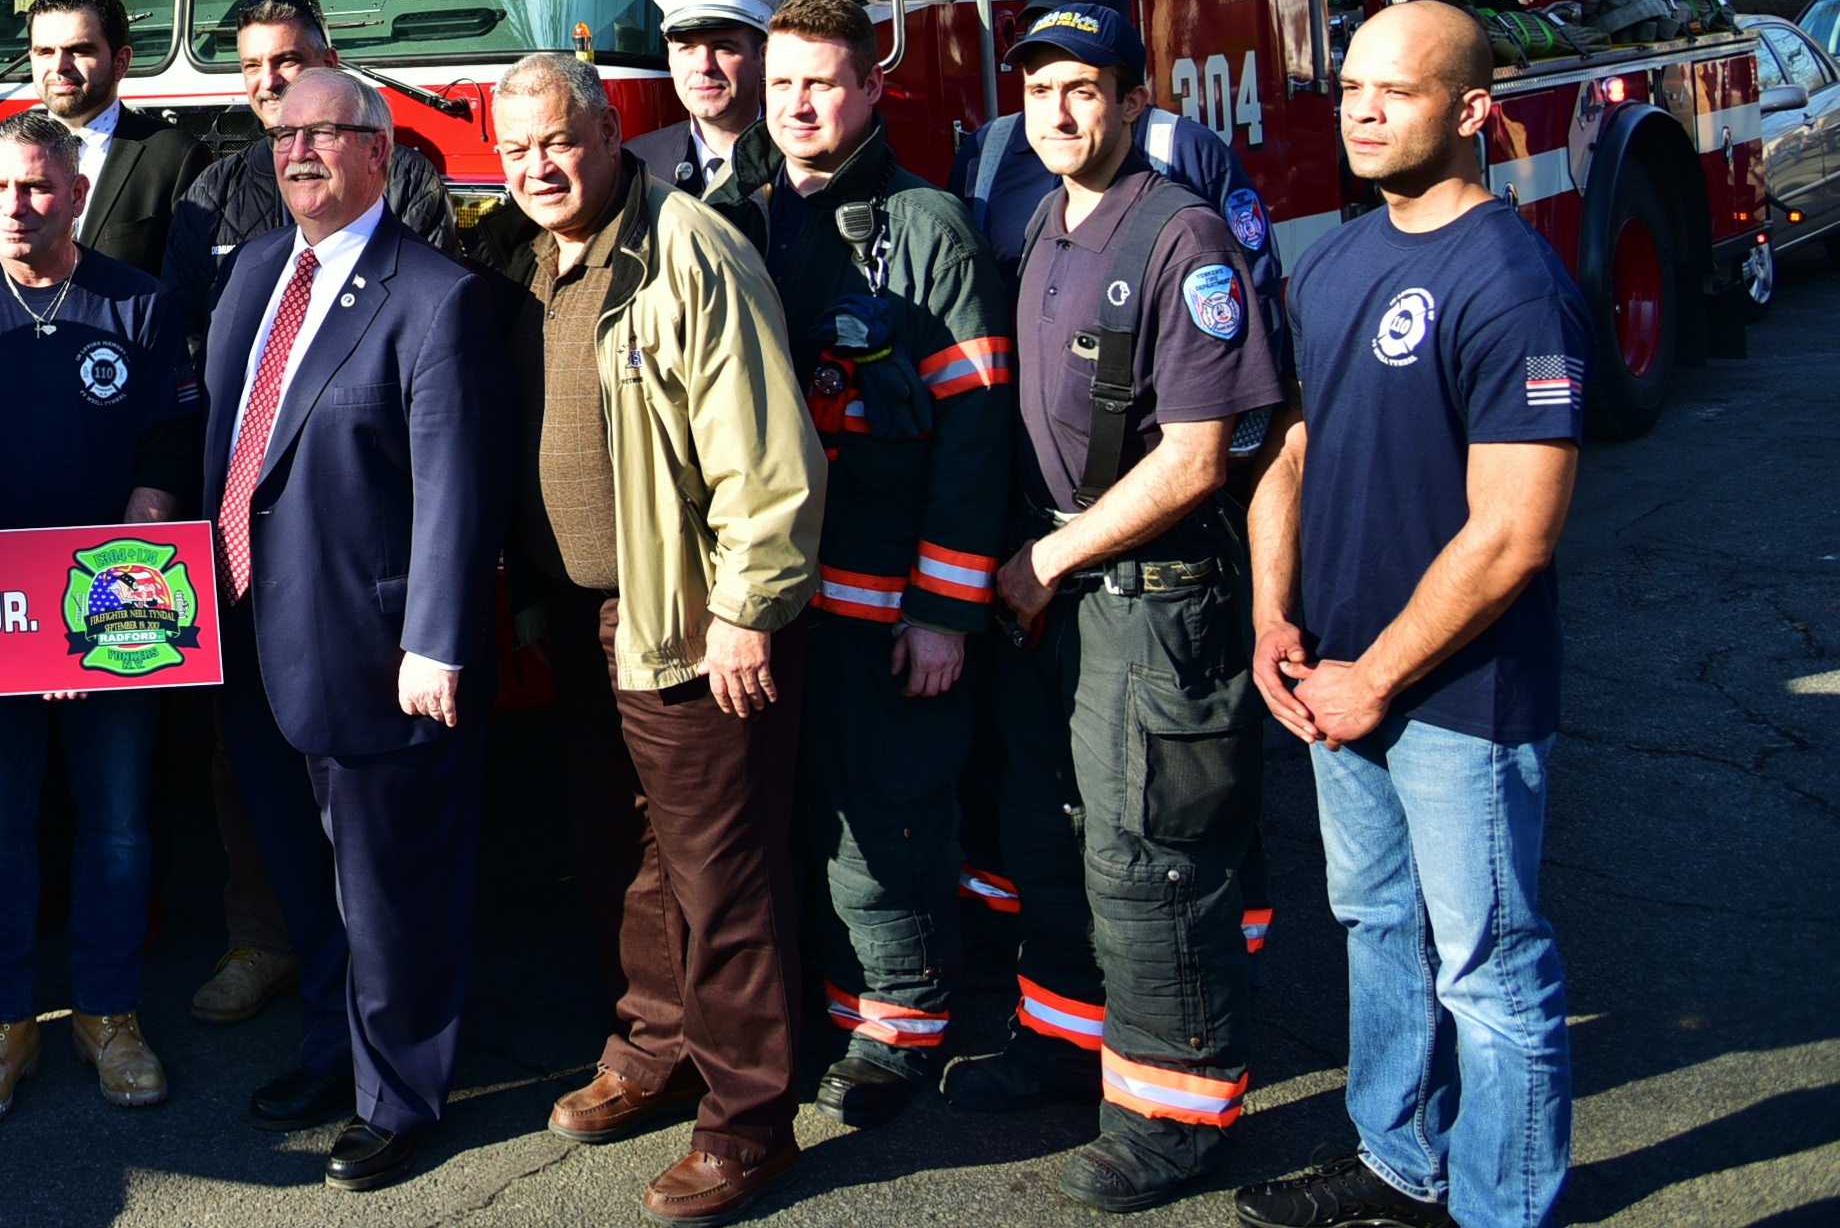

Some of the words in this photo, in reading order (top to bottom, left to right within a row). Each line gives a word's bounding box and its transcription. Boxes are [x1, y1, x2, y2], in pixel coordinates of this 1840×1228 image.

[1172, 50, 1263, 147] 304
[94, 366, 114, 380] 110
[90, 610, 129, 626] FIREFIGHTER
[149, 610, 176, 622] TYNDAL
[99, 631, 158, 643] RADFORD
